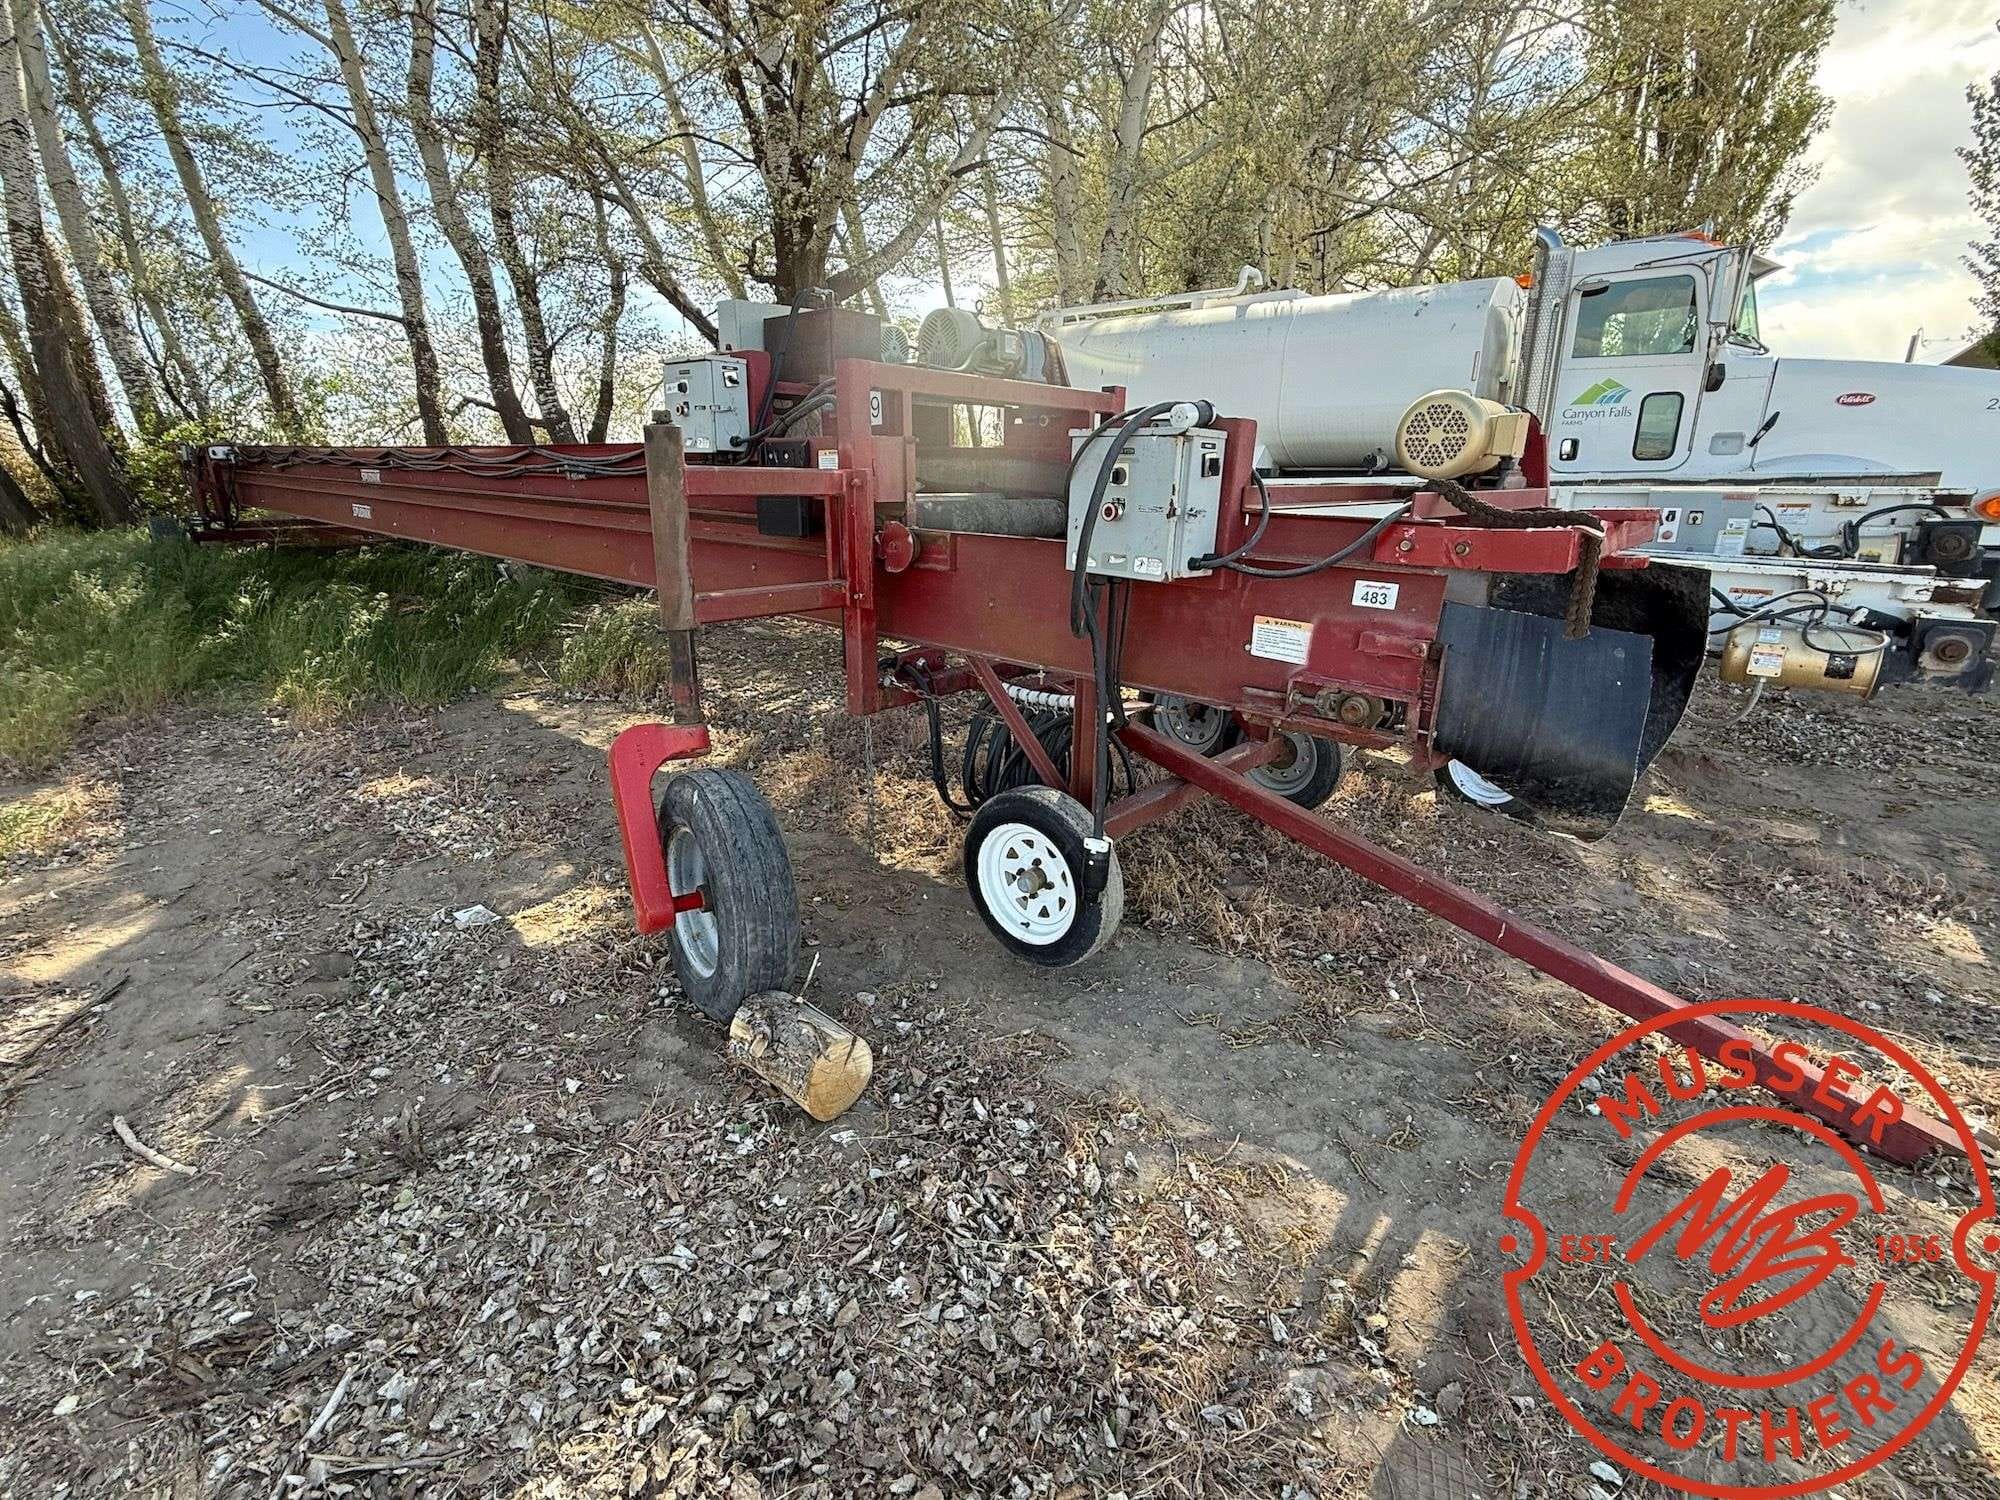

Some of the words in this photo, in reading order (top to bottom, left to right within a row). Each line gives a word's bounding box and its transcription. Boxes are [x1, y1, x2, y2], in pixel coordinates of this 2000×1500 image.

[870, 396, 880, 418] 9
[1986, 398, 2000, 410] 2
[1562, 408, 1605, 421] Canyon
[1608, 406, 1632, 418] Falls
[1361, 591, 1388, 605] 483
